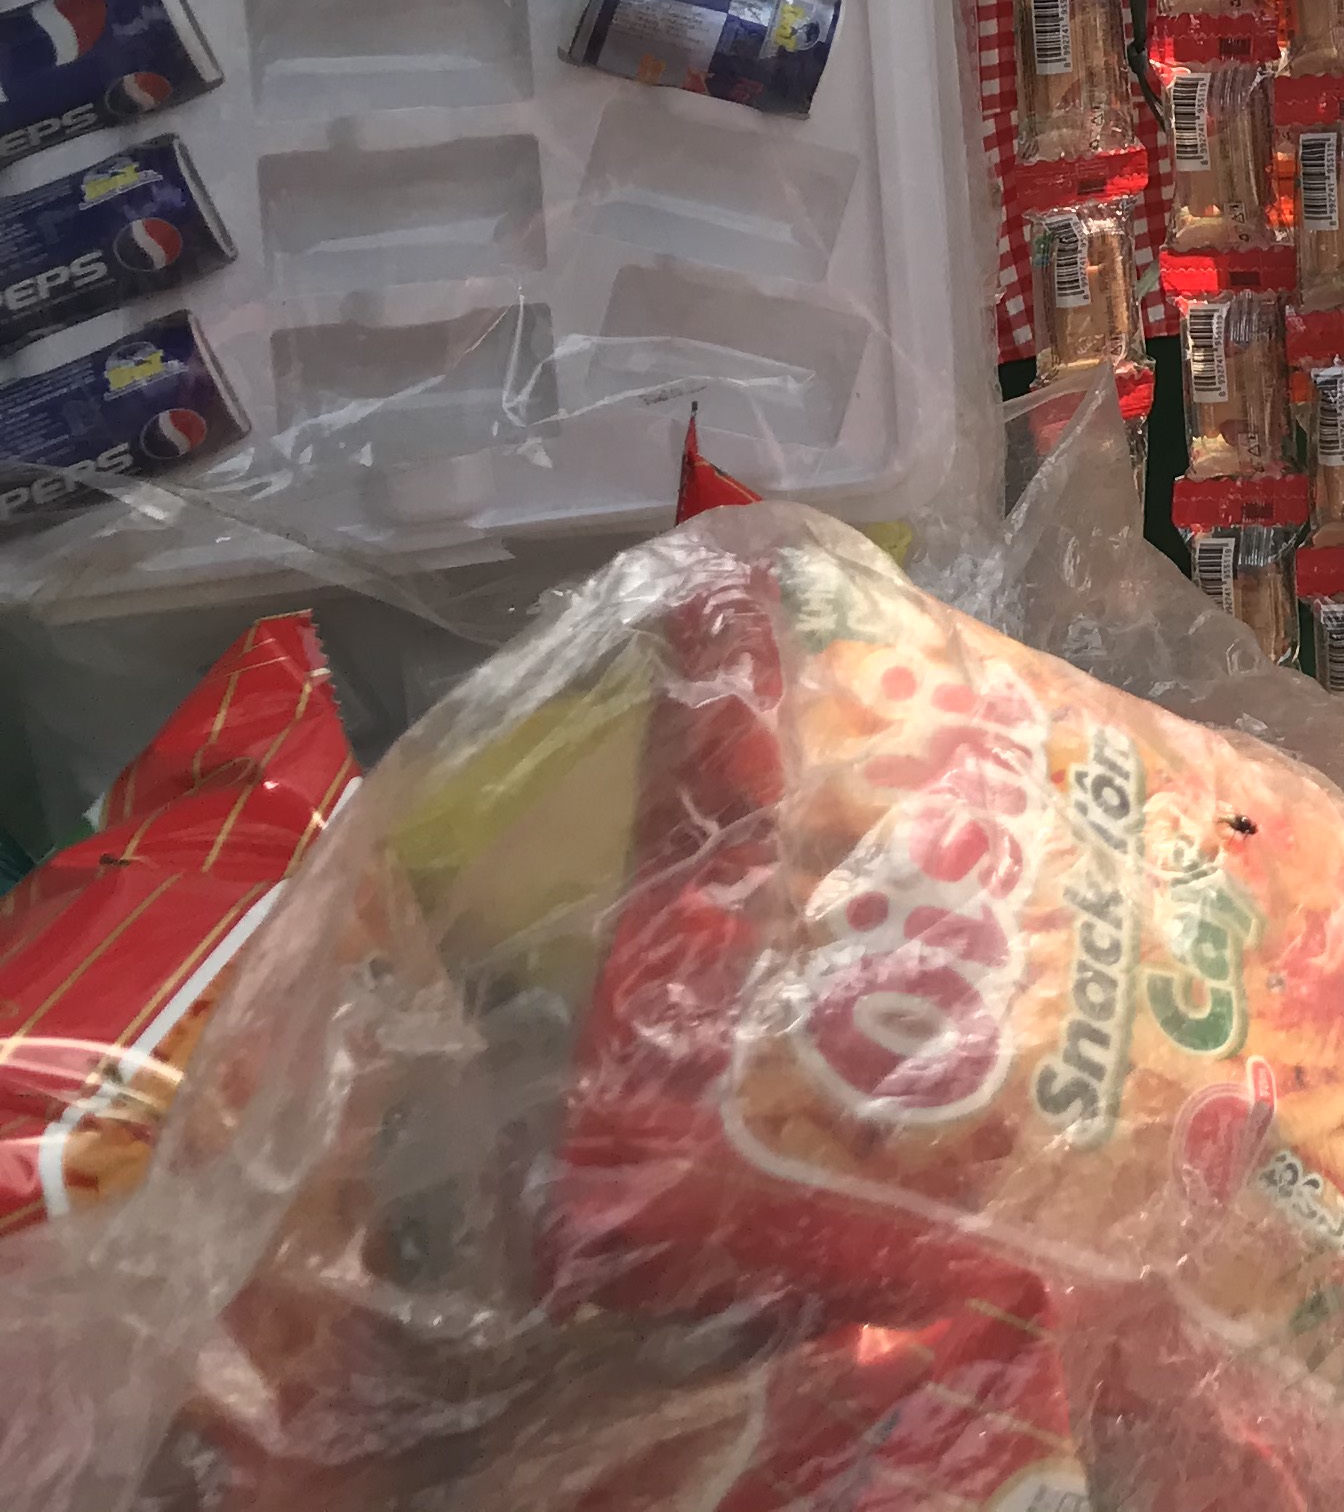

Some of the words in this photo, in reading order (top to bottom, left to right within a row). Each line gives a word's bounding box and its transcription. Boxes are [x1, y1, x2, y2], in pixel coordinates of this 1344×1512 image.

[1062, 25, 1070, 55] 992741
[1197, 83, 1206, 113] 955119
[1198, 123, 1207, 153] 992741
[1214, 315, 1223, 346] 955119
[1216, 355, 1224, 385] 992741
[1038, 866, 1131, 1130] Snack
